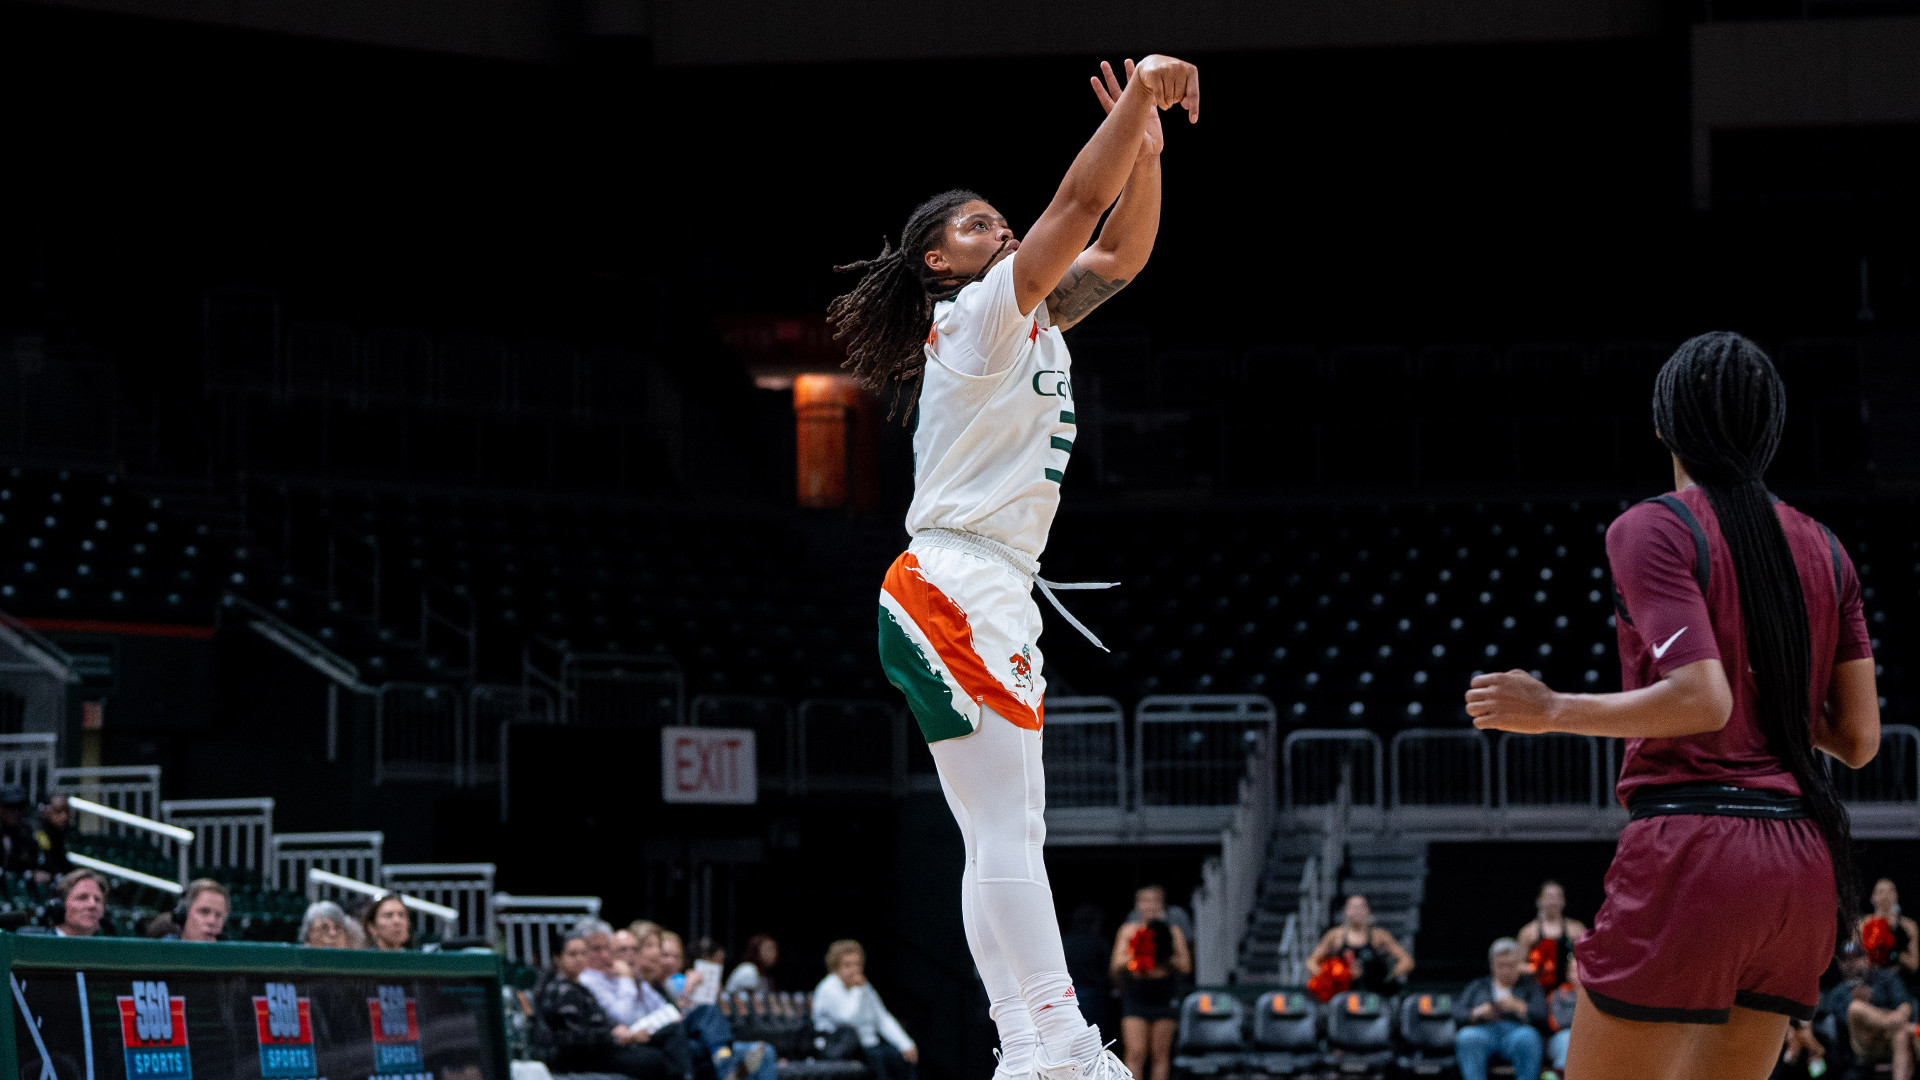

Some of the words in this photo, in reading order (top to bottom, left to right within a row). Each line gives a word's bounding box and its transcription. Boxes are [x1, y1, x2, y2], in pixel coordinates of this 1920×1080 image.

[675, 738, 740, 793] EXIT
[132, 980, 173, 1040] 560
[135, 1052, 183, 1074] SPORTS
[268, 1049, 310, 1068] SPORTS
